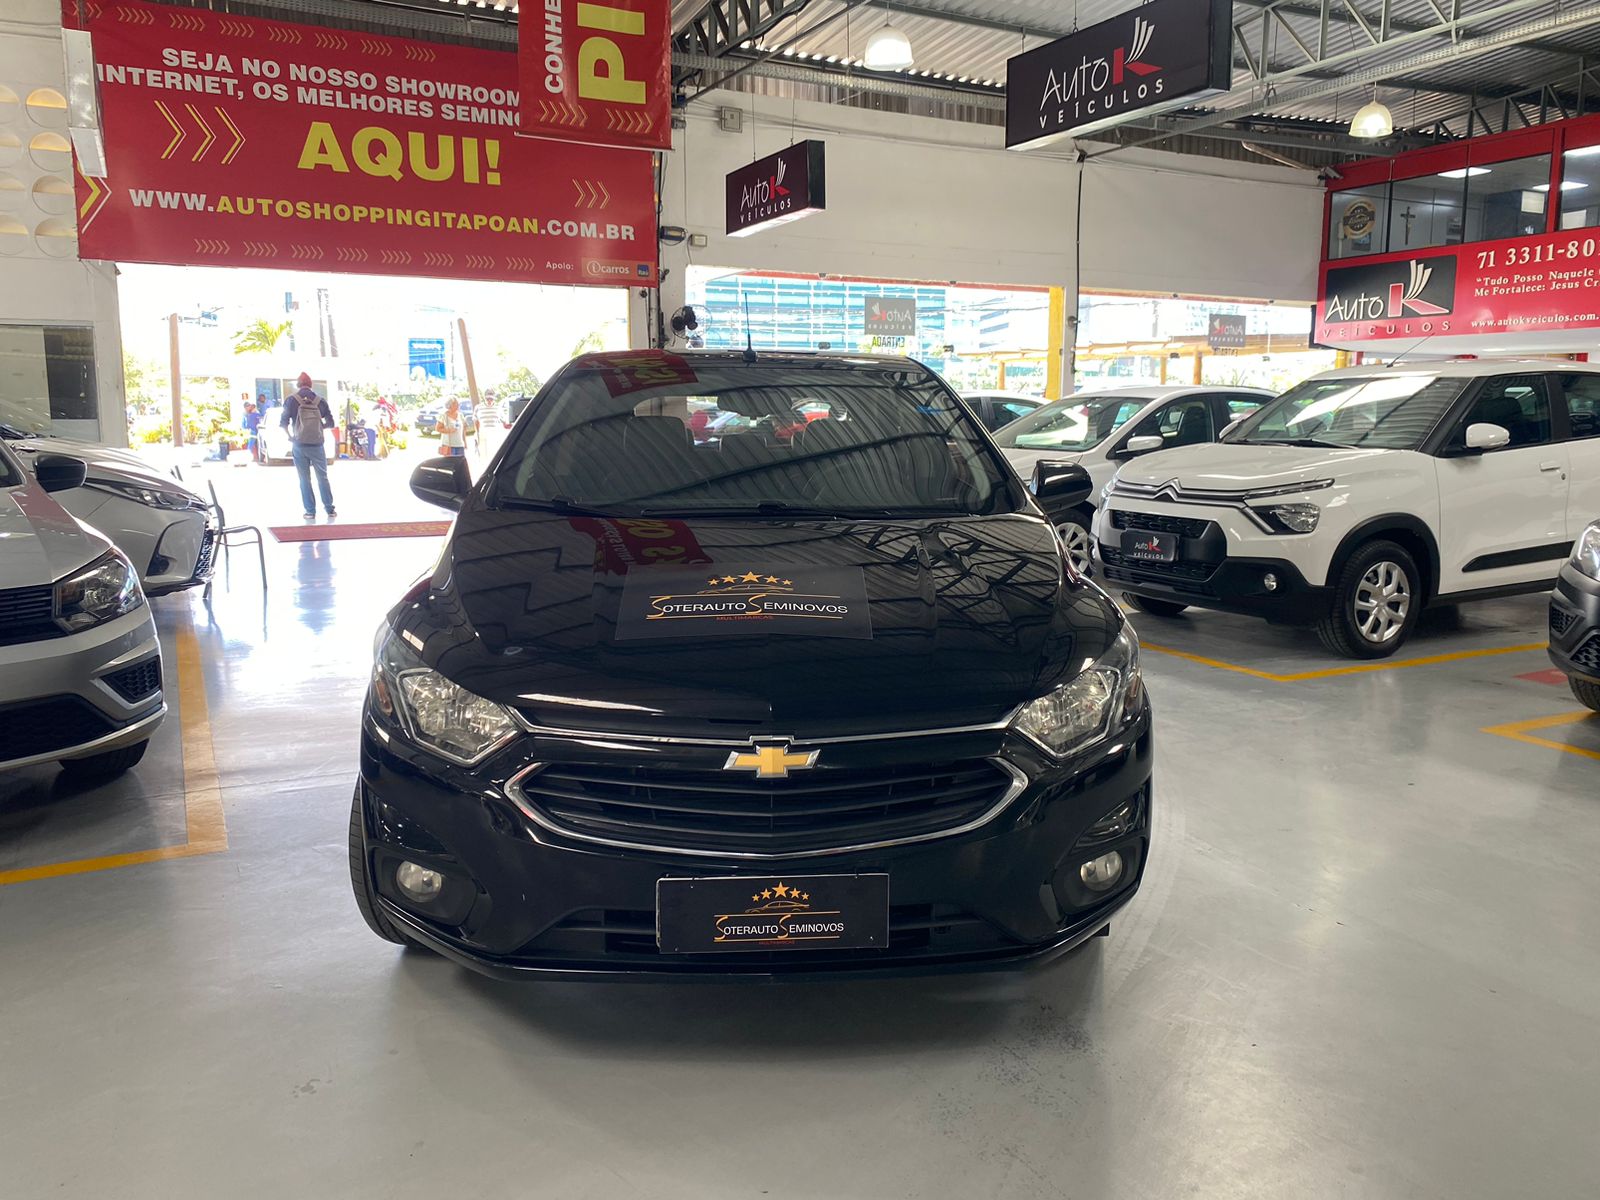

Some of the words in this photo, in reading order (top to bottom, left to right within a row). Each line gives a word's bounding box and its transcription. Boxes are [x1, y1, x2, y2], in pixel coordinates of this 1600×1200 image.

[162, 47, 234, 73] SEJA
[242, 57, 281, 79] NO
[289, 63, 378, 91] NOSSO
[384, 75, 520, 107] SHOWROOM
[577, 2, 647, 104] PI
[96, 63, 244, 100] INTERNET,
[252, 82, 289, 101] OS
[297, 86, 435, 119] MELHORES
[297, 120, 501, 186] AQUI!
[128, 188, 636, 241] WWW.AUTOSHOPPINGITAPOAN.COM.BR
[1477, 250, 1496, 269] 71
[1505, 238, 1600, 266] 3311-80
[1513, 273, 1543, 284] Posso
[1548, 267, 1594, 280] Naquele
[1474, 287, 1490, 297] Me
[1492, 283, 1546, 296] Fortalece:
[1550, 280, 1580, 291] Jesus
[1584, 277, 1600, 288] Cr
